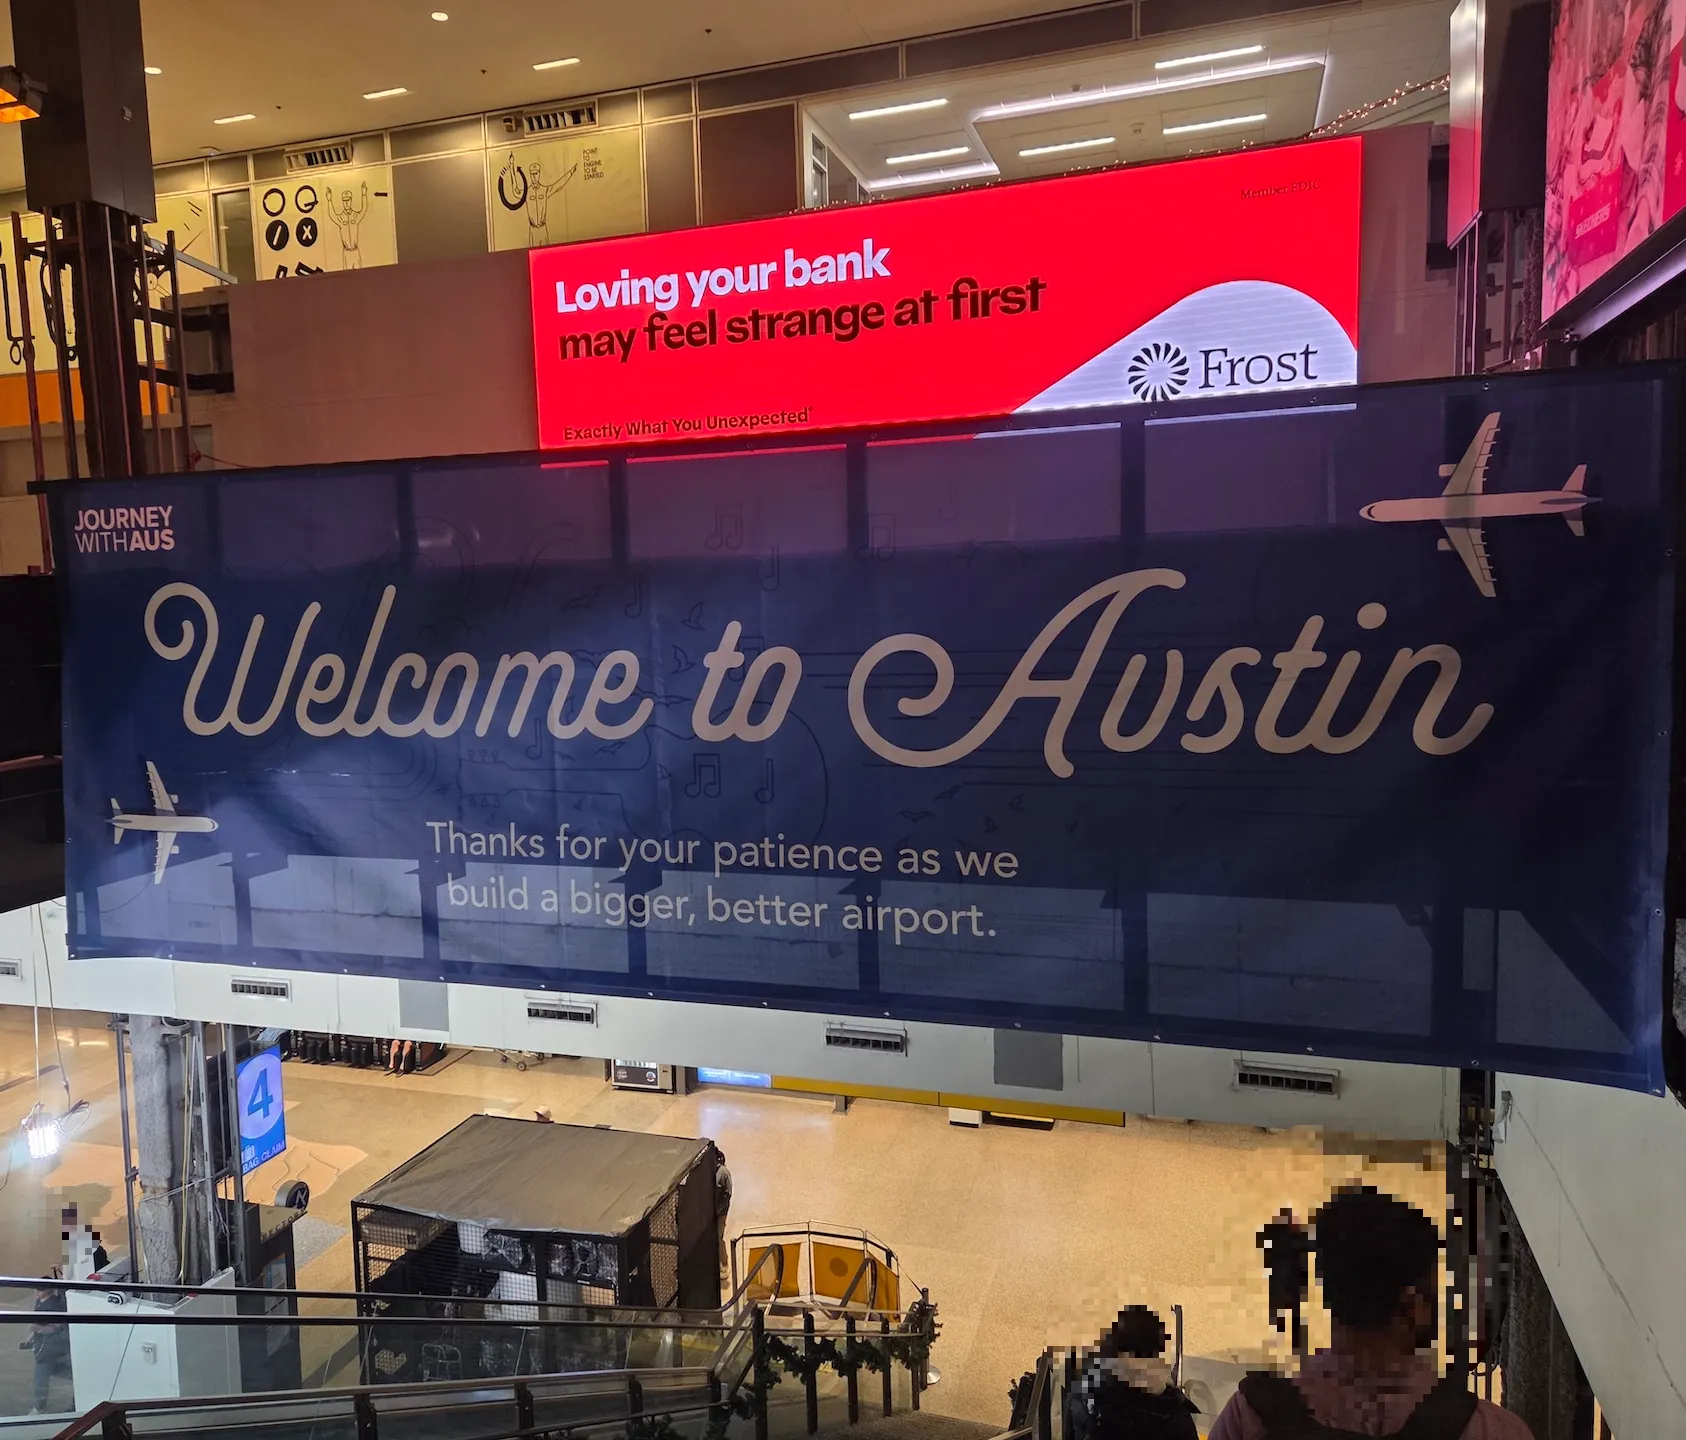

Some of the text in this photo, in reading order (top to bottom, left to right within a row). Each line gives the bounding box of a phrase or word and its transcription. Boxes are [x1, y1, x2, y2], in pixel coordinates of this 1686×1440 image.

[1240, 179, 1321, 199] Member FDIC
[556, 238, 891, 313] Loving your bank
[559, 276, 1047, 363] may feel strange at first
[1199, 344, 1319, 389] Frost
[564, 422, 622, 440] Exactly
[625, 420, 669, 435] What
[672, 418, 702, 432] You
[74, 505, 173, 532] JOURNEY
[144, 567, 1495, 779] Welcome to Austin
[426, 820, 1019, 879] Thanks for your patience as we
[447, 872, 997, 946] build a bigger, better airport.
[247, 1067, 274, 1120] 4
[242, 1139, 285, 1174] BAG CLAIM
